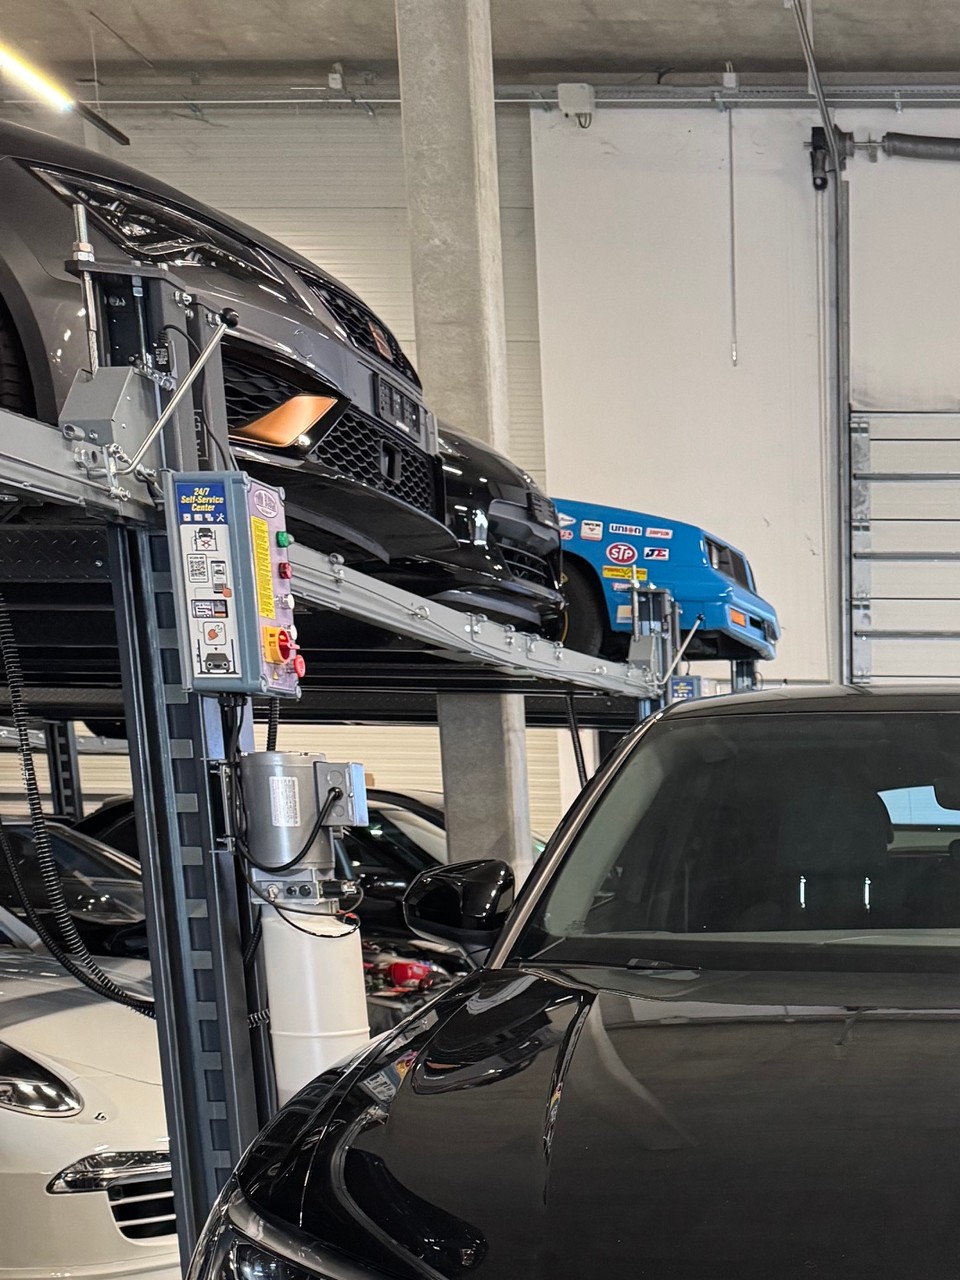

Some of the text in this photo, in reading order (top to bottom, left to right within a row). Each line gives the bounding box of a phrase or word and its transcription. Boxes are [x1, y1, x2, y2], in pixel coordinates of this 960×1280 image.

[193, 487, 210, 496] 24/7
[180, 495, 224, 504] Self-Service
[191, 503, 215, 512] Center
[611, 545, 633, 560] STP
